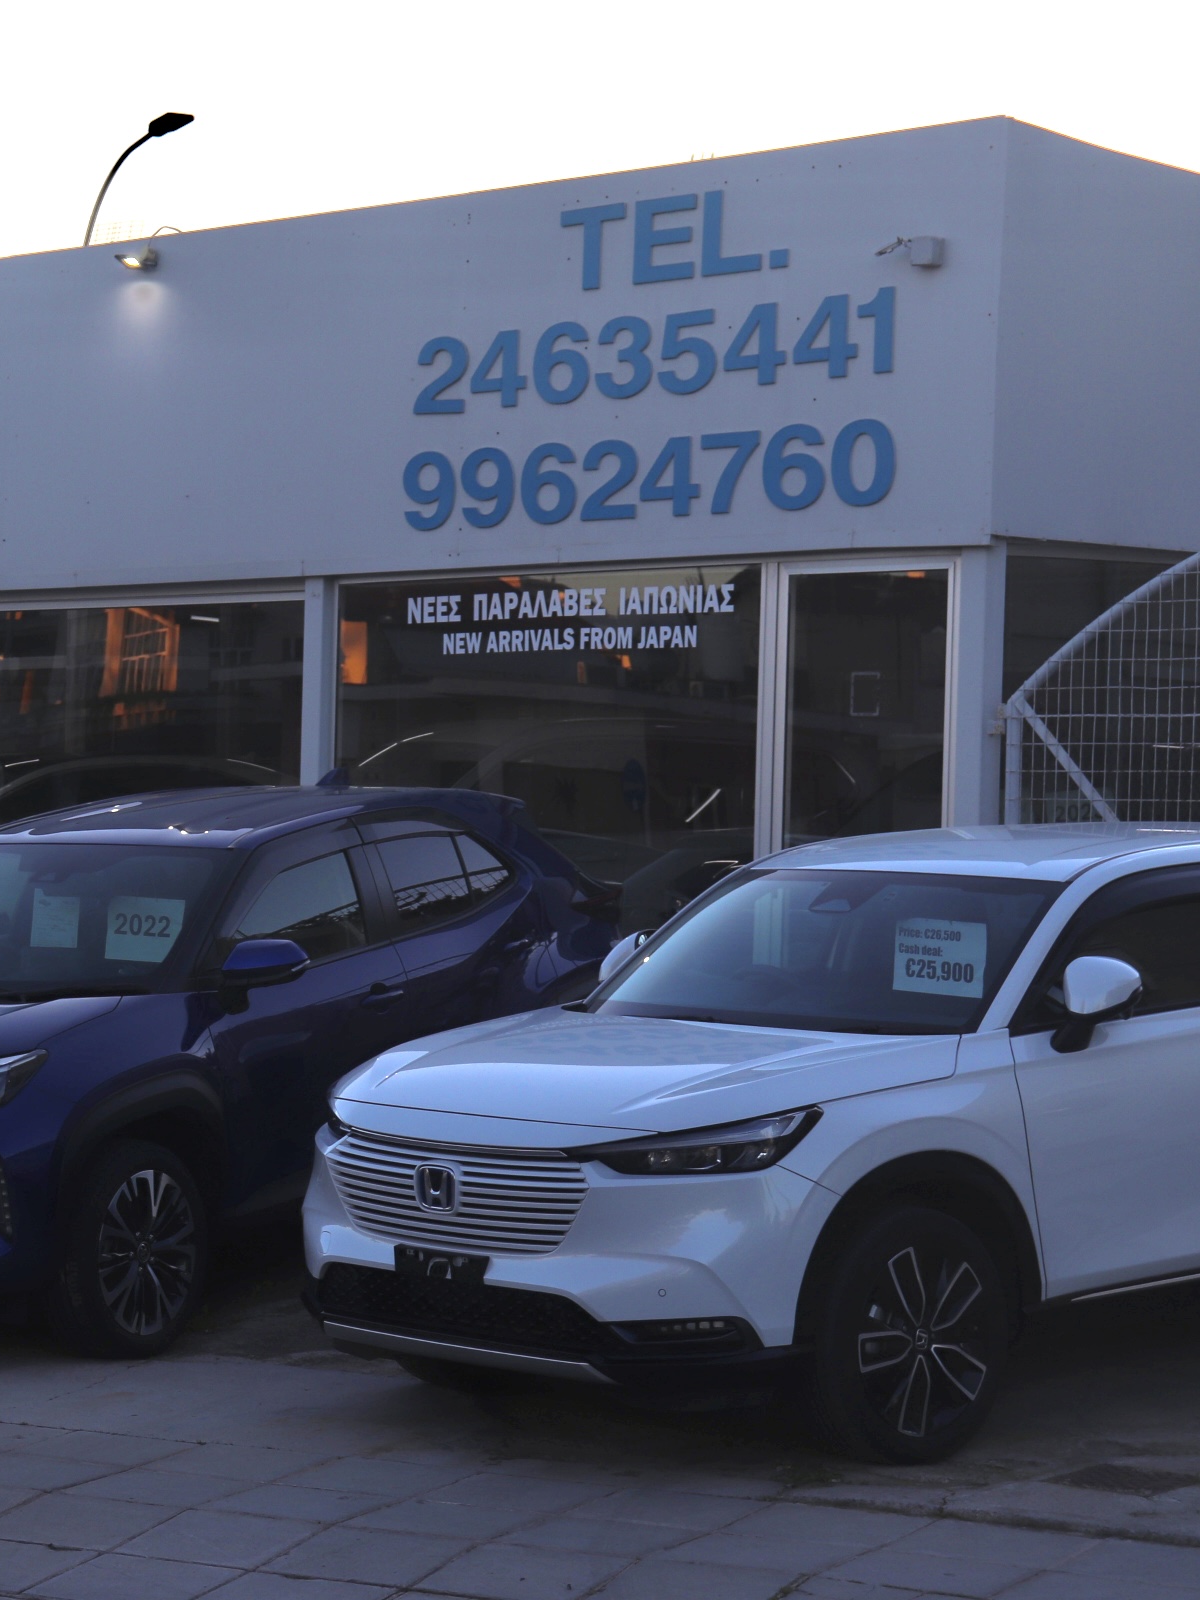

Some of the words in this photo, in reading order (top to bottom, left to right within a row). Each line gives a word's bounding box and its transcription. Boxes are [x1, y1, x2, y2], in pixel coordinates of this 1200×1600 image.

[560, 189, 790, 291] TEL.
[413, 286, 896, 415] 24635441
[402, 418, 897, 531] 99624760
[407, 595, 461, 624] ΝΕΕΣ
[473, 588, 607, 622] ΠΑΡΑΛΑΒΕΣ
[619, 583, 735, 616] ΙΑΠΩΝΙΑΣ
[442, 632, 482, 655] NEW
[485, 628, 575, 654] ARRIVALS
[580, 626, 633, 650] FROM
[637, 625, 698, 649] JAPAN
[114, 913, 171, 938] 2022
[898, 926, 923, 938] Price:
[924, 928, 962, 942] €26,500
[898, 943, 920, 955] Cash
[921, 945, 943, 957] deal:
[905, 957, 974, 983] €25,900
